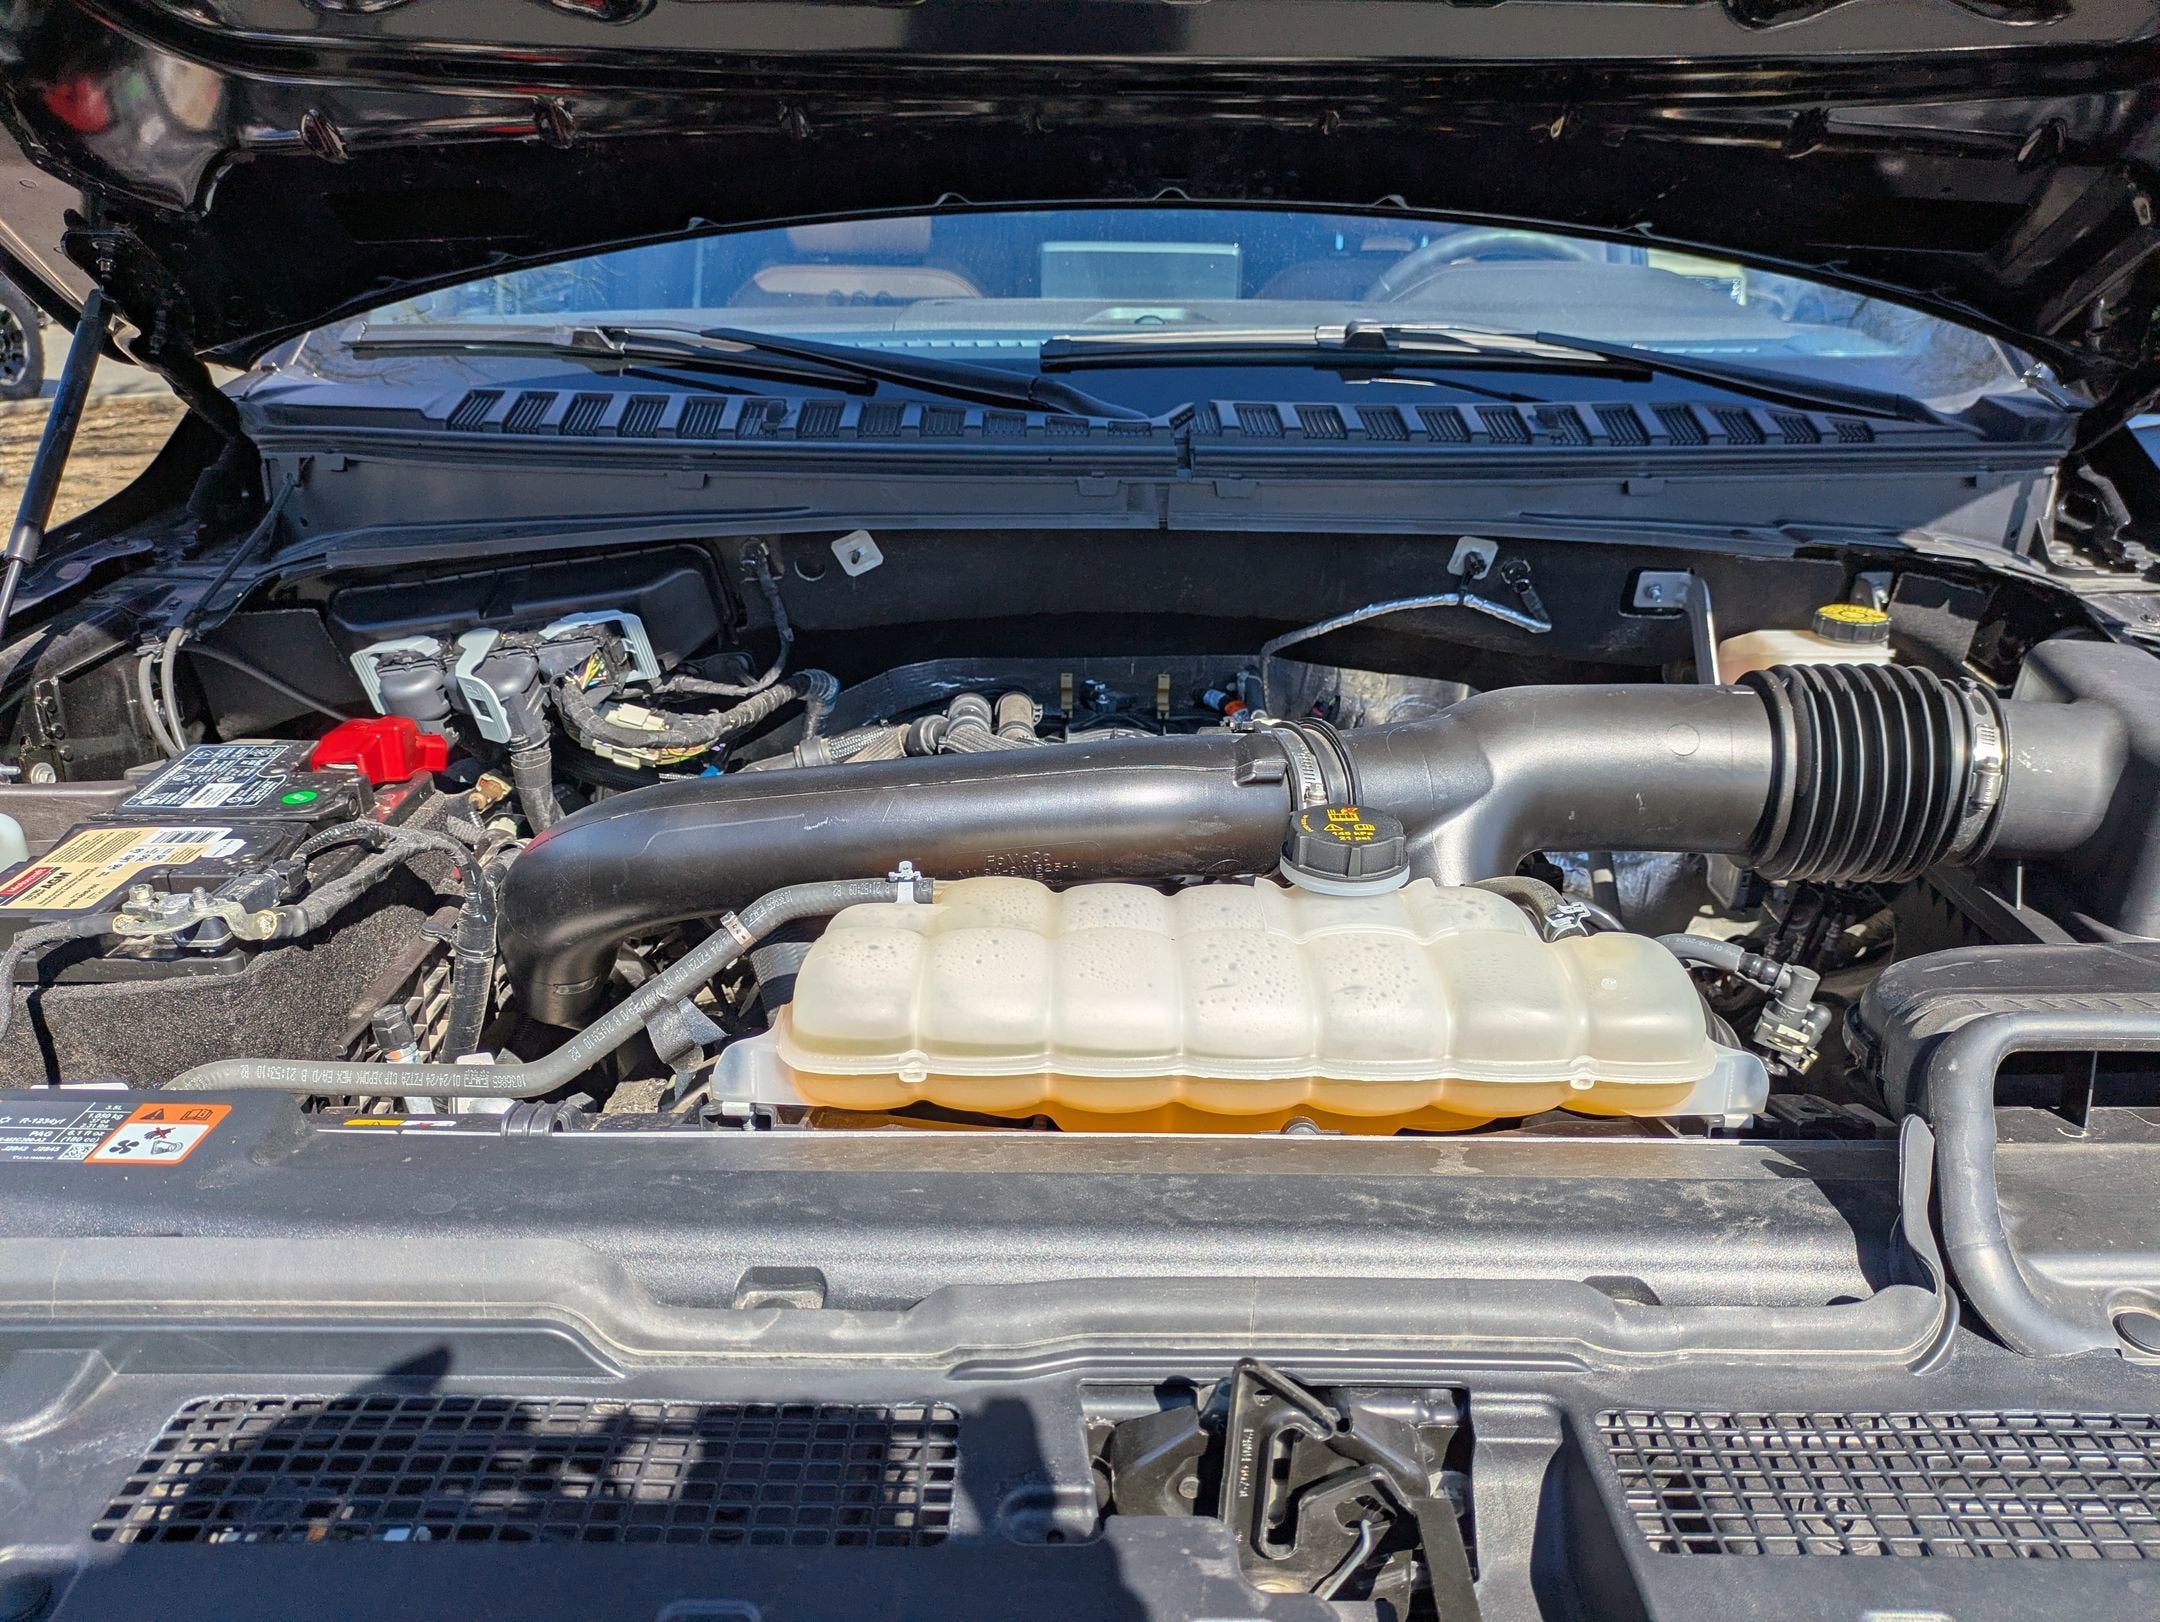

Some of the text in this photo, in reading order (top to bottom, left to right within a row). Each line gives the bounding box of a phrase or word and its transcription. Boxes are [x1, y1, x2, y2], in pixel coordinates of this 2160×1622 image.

[986, 851, 1051, 866] FoMoCo
[6, 868, 47, 892] Motorcraft
[41, 872, 73, 890] AGM
[256, 1064, 297, 1082] 21:53:10
[336, 1069, 352, 1084] MEX
[425, 1073, 460, 1087] 01/24/24
[18, 1117, 67, 1126] R-1234yf
[111, 1113, 124, 1121] kg
